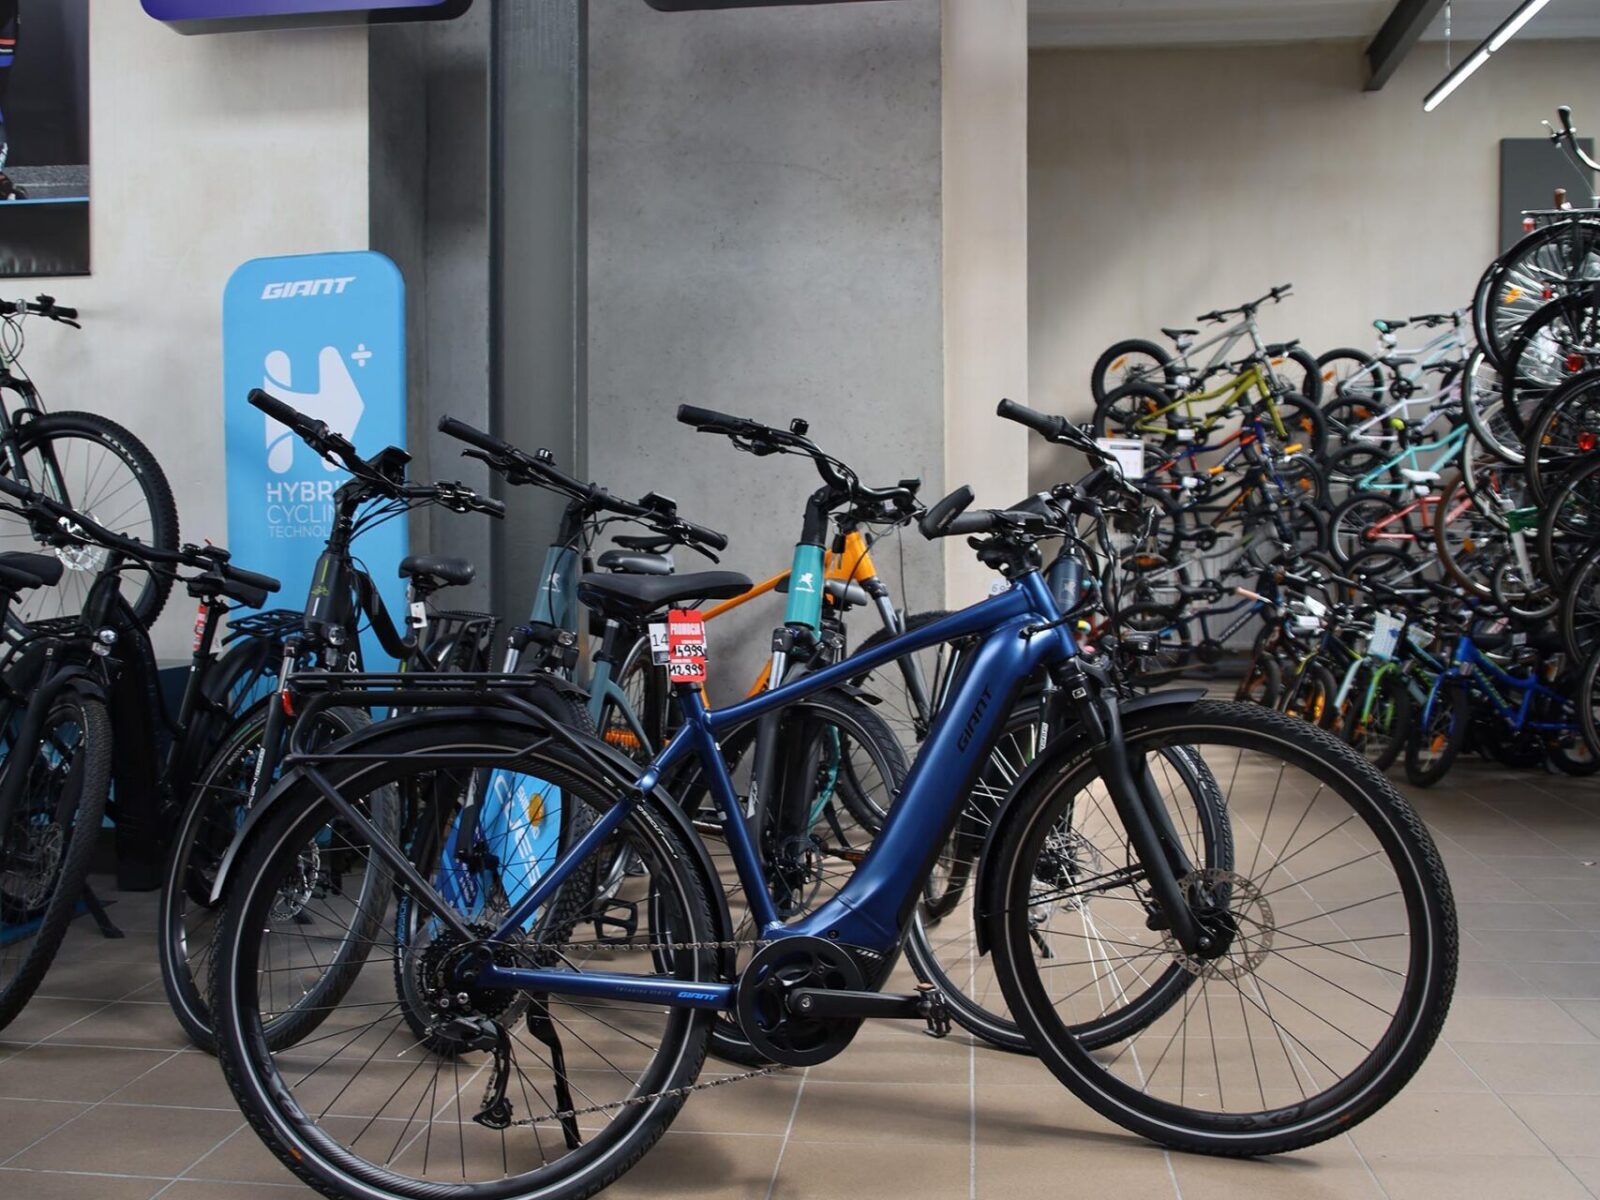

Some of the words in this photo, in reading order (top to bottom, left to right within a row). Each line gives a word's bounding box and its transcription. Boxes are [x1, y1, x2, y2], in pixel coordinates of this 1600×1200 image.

[261, 277, 356, 299] GIANT
[266, 480, 347, 502] HYBR
[957, 685, 992, 753] GIANT
[678, 991, 719, 1000] GIANT
